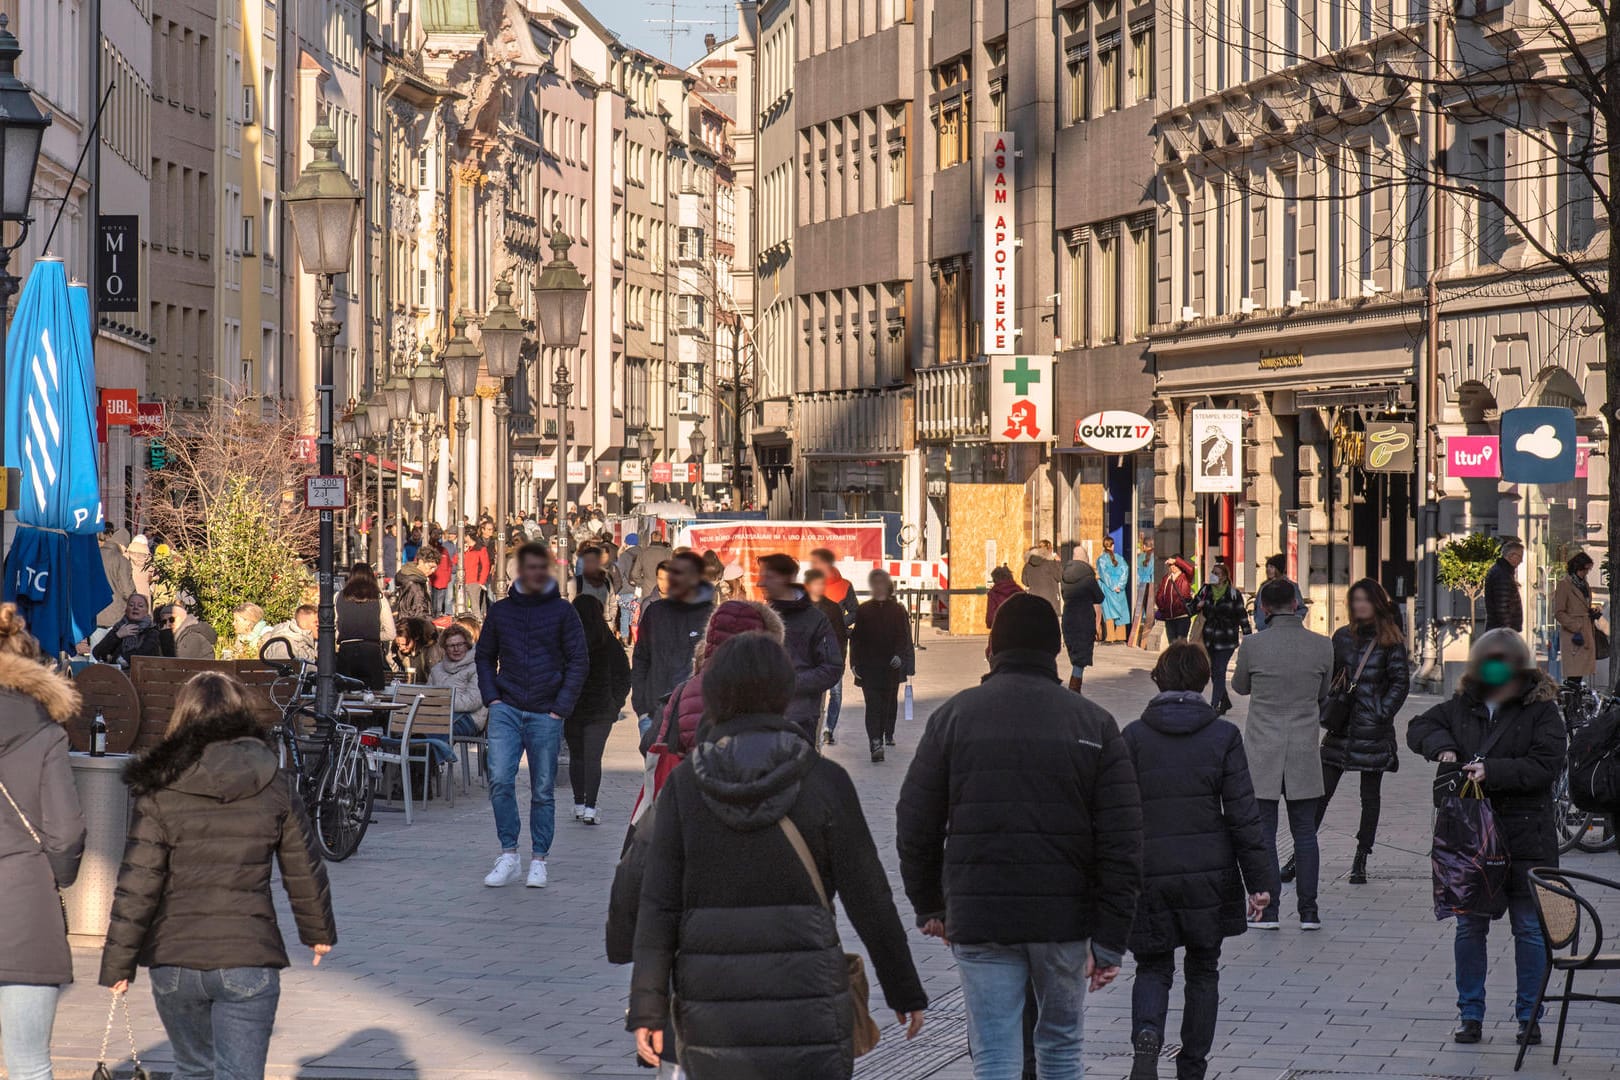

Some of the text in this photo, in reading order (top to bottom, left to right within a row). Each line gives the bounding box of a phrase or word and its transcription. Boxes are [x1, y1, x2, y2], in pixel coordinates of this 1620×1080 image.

[994, 138, 1007, 349] ASAM APOTHEKE
[106, 232, 124, 295] MIO
[108, 400, 132, 414] JBL
[1135, 425, 1150, 439] 17
[310, 479, 337, 487] H 300
